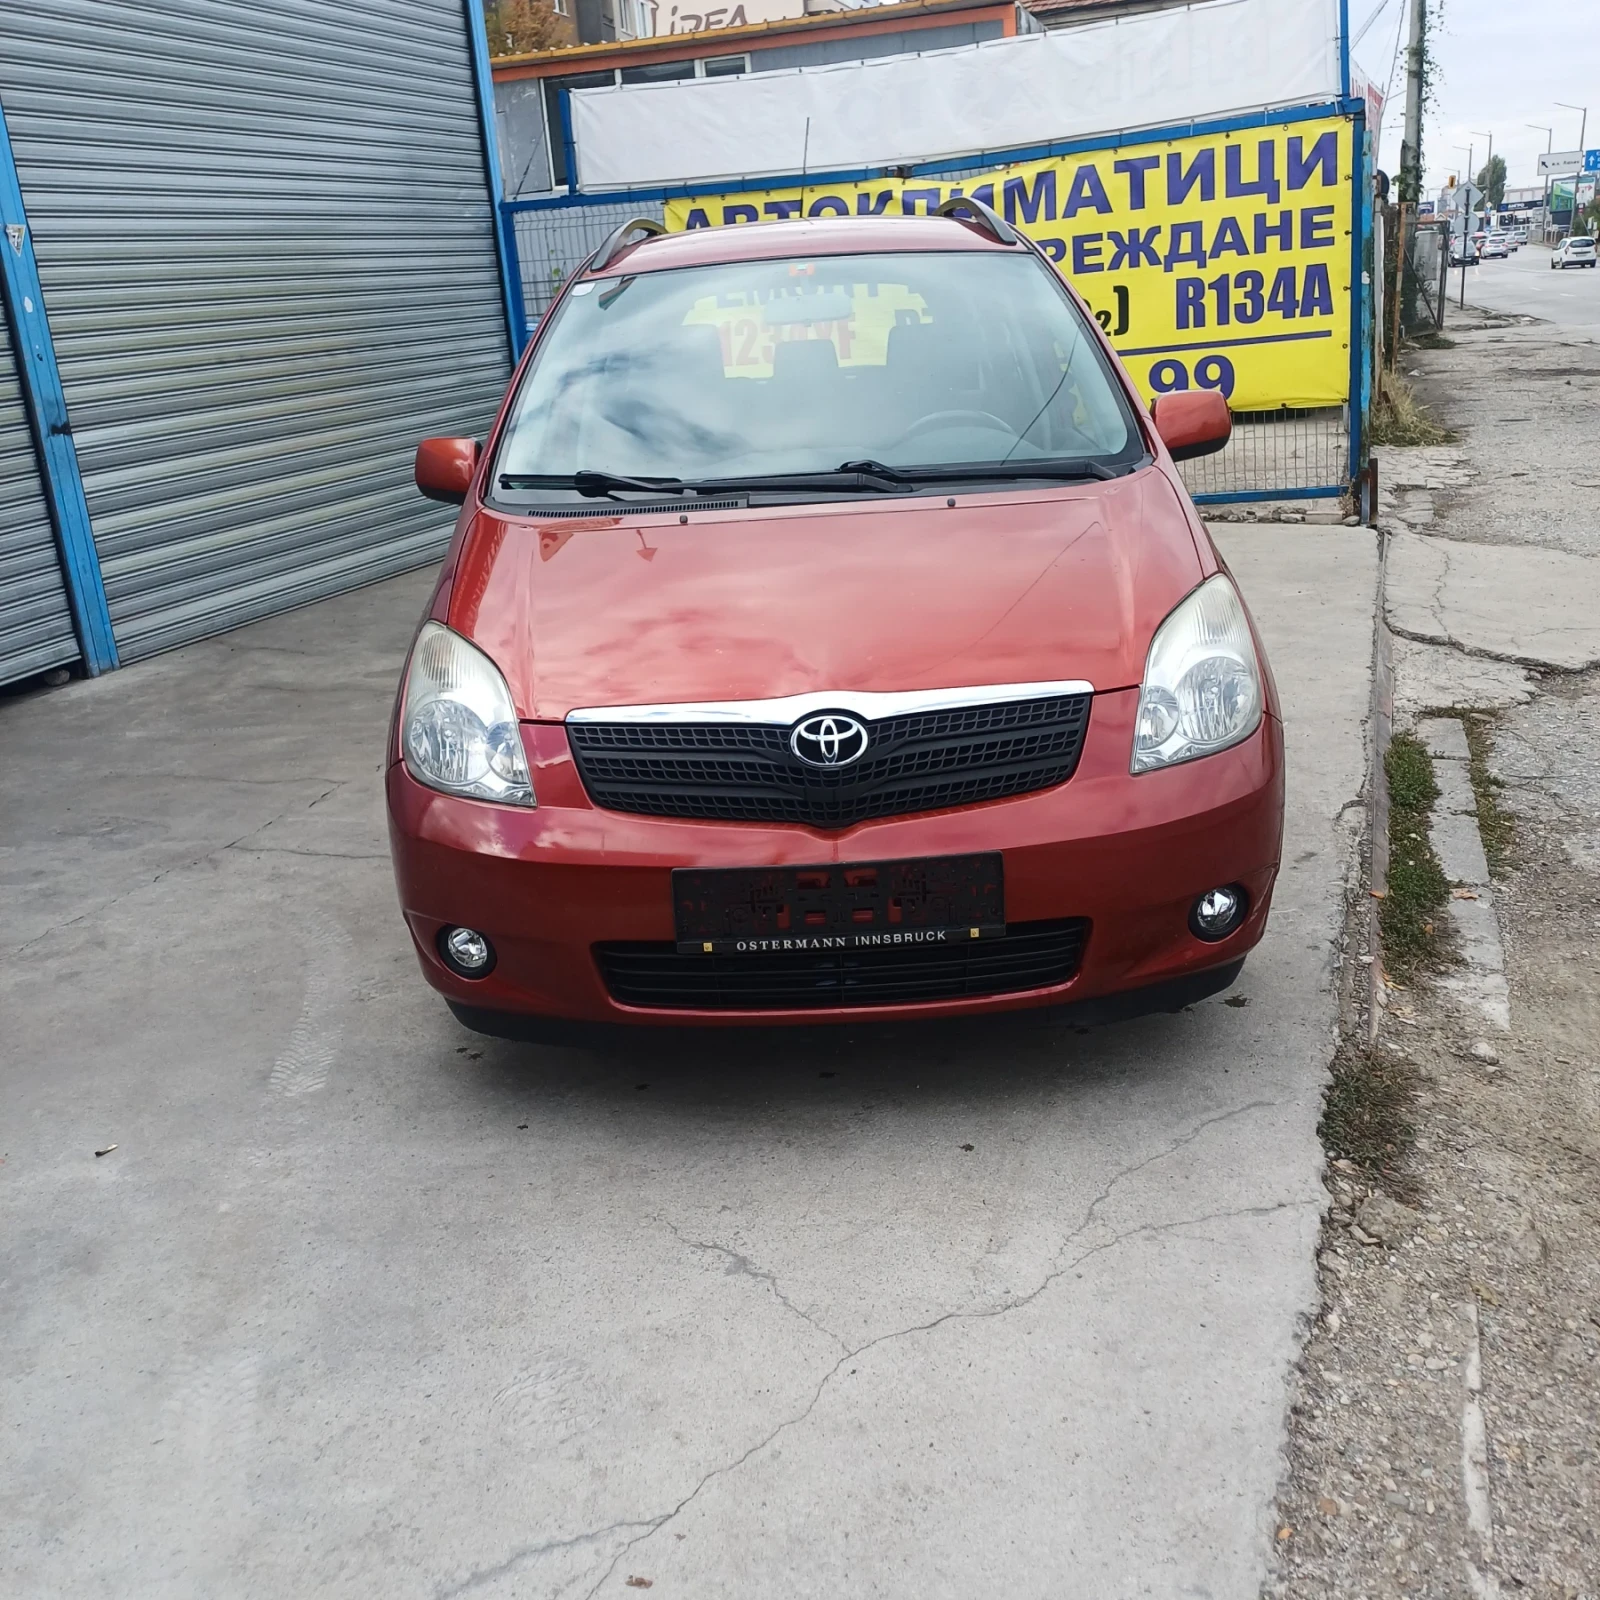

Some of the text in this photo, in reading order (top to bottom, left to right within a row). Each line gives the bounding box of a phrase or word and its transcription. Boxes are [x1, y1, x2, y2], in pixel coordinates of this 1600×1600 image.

[1176, 263, 1334, 330] R134A
[736, 930, 946, 951] OSTERMANN INNSBRUCK
